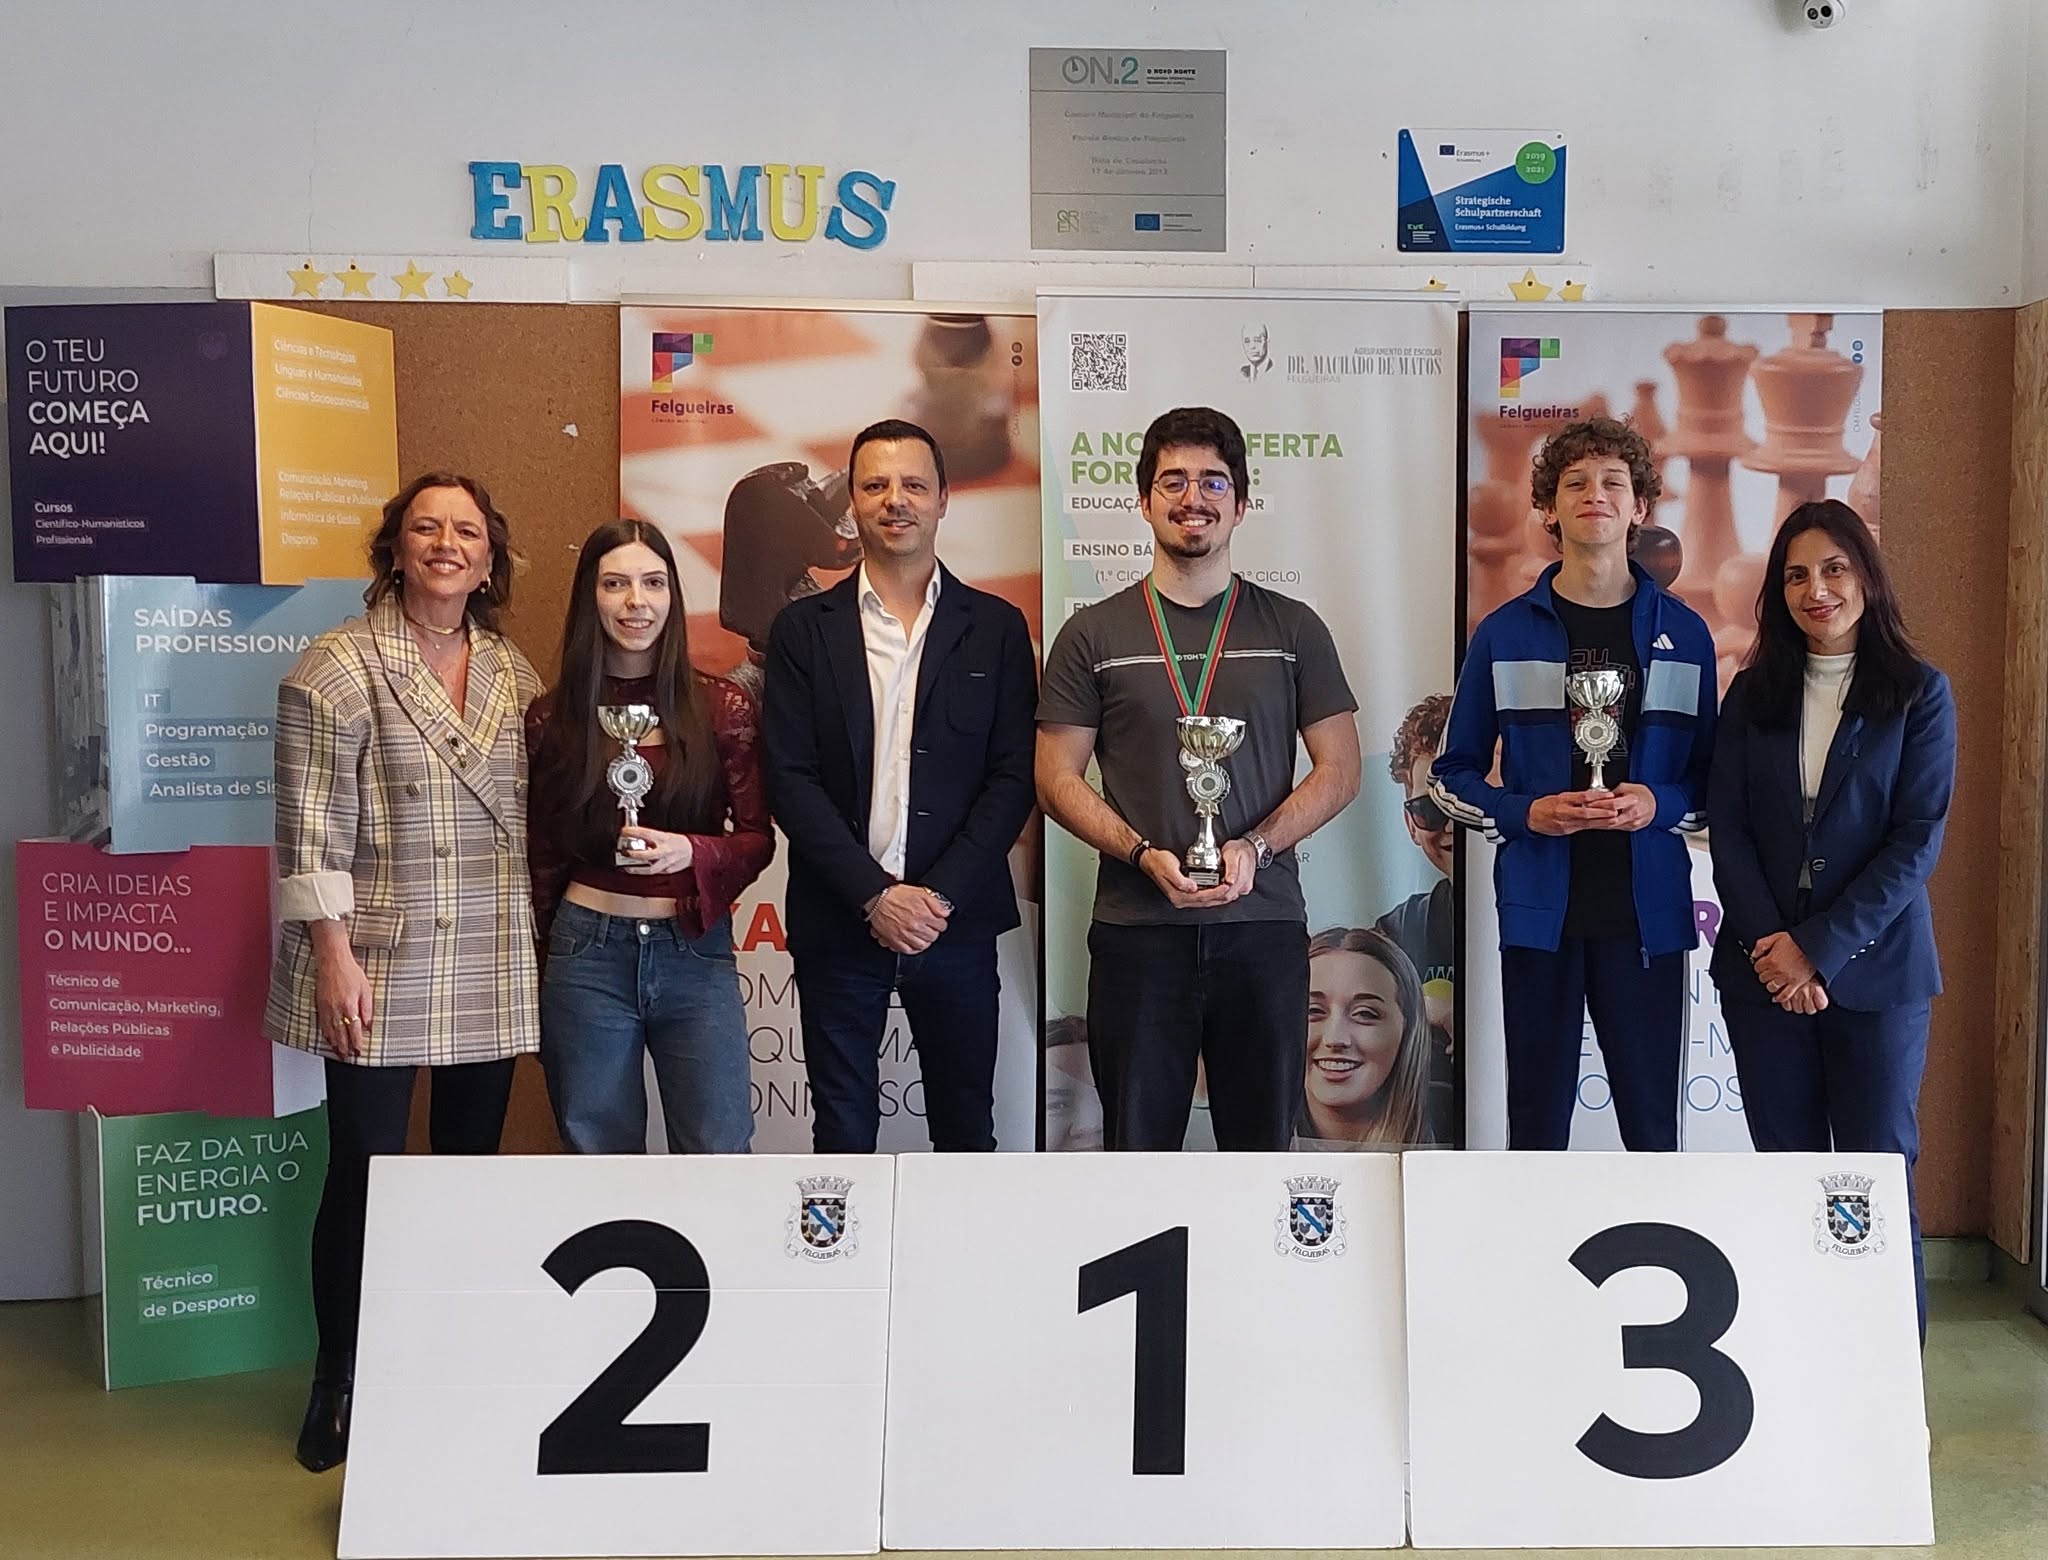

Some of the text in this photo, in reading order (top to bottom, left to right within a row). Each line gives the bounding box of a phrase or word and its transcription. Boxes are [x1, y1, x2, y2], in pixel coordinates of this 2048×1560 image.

[468, 161, 896, 250] ERASMUS
[1455, 196, 1512, 207] Strategische
[1455, 208, 1542, 219] Schulpartnerschaft
[26, 339, 105, 363] O TEU
[1354, 347, 1442, 356] AGRUPAMENTO DE ESCOLAS
[1287, 355, 1442, 376] DR. MACHADO DE MATOS
[28, 369, 139, 394] FUTURO
[29, 401, 150, 430] COMEÇA
[651, 398, 734, 416] Felgueiras
[1499, 405, 1579, 421] Felgueiras
[29, 431, 106, 459] AQUI!
[1071, 432, 1094, 456] A
[1246, 433, 1343, 457] FERTA
[35, 502, 73, 513] Cursos
[1072, 544, 1129, 556] ENSINO
[1255, 570, 1301, 584] CICLO)
[134, 605, 233, 628] SAÍDAS
[136, 634, 311, 653] PROFISSIONA
[144, 693, 161, 708] IT
[145, 722, 269, 740] Programação
[146, 752, 211, 767] Gestão
[149, 781, 223, 797] Analista
[228, 781, 251, 795] de
[42, 872, 192, 896] CRIA IDEIAS
[44, 900, 178, 924] E IMPACTA
[44, 929, 192, 953] O MUNDO...
[48, 973, 120, 988] Técnico de
[50, 998, 221, 1017] Comunicação, Marketing,
[51, 1021, 170, 1037] Relações Públicas
[51, 1042, 141, 1058] e Publicidade
[136, 1131, 309, 1167] FAZ DA TUA
[137, 1161, 300, 1197] ENERGIA O
[137, 1193, 268, 1227] FUTURO.
[142, 1270, 214, 1291] Técnico
[143, 1291, 256, 1319] de Desporto
[537, 1219, 710, 1475] 2
[1077, 1225, 1188, 1476] 1
[1568, 1221, 1755, 1480] 3
